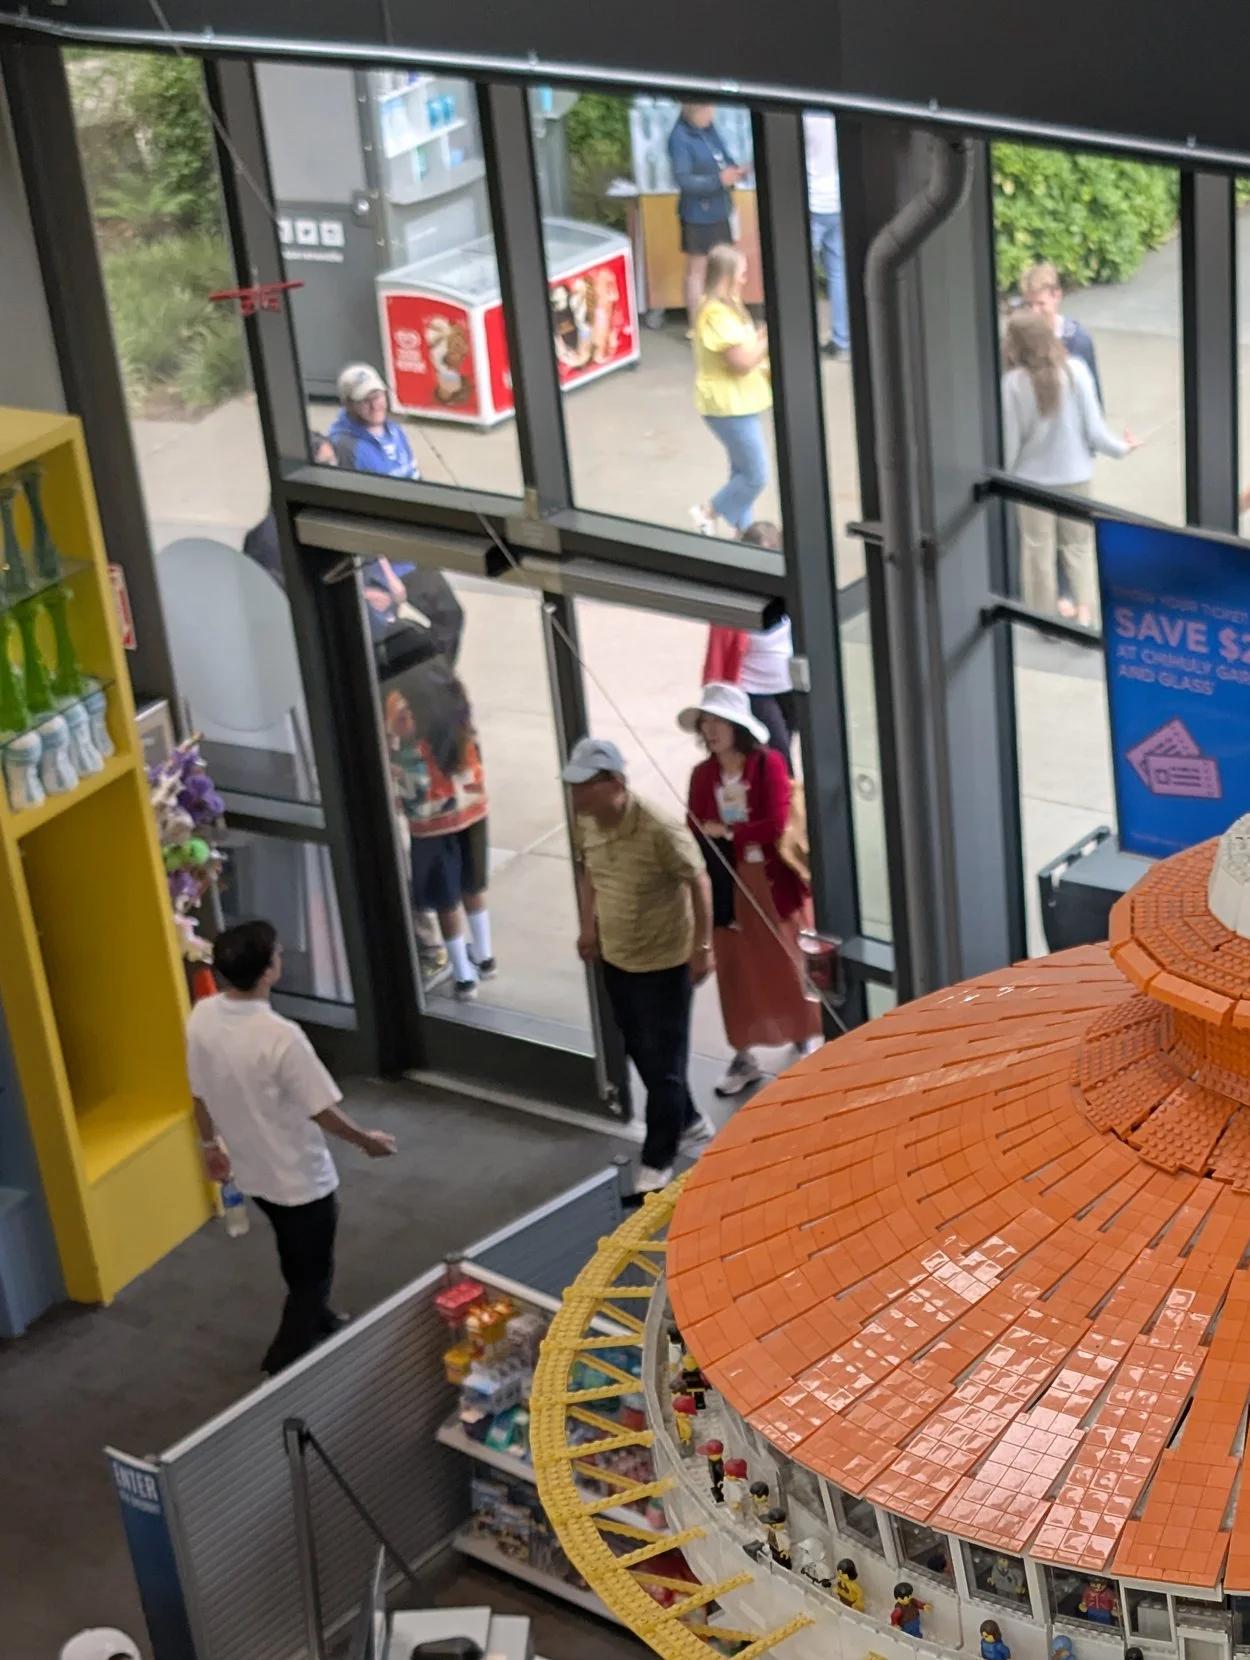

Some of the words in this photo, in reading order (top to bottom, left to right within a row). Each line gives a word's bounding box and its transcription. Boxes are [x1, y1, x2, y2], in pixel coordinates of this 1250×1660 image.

[1115, 607, 1209, 654] SAVE
[1120, 664, 1155, 682] AND
[1158, 672, 1214, 695] GLASS
